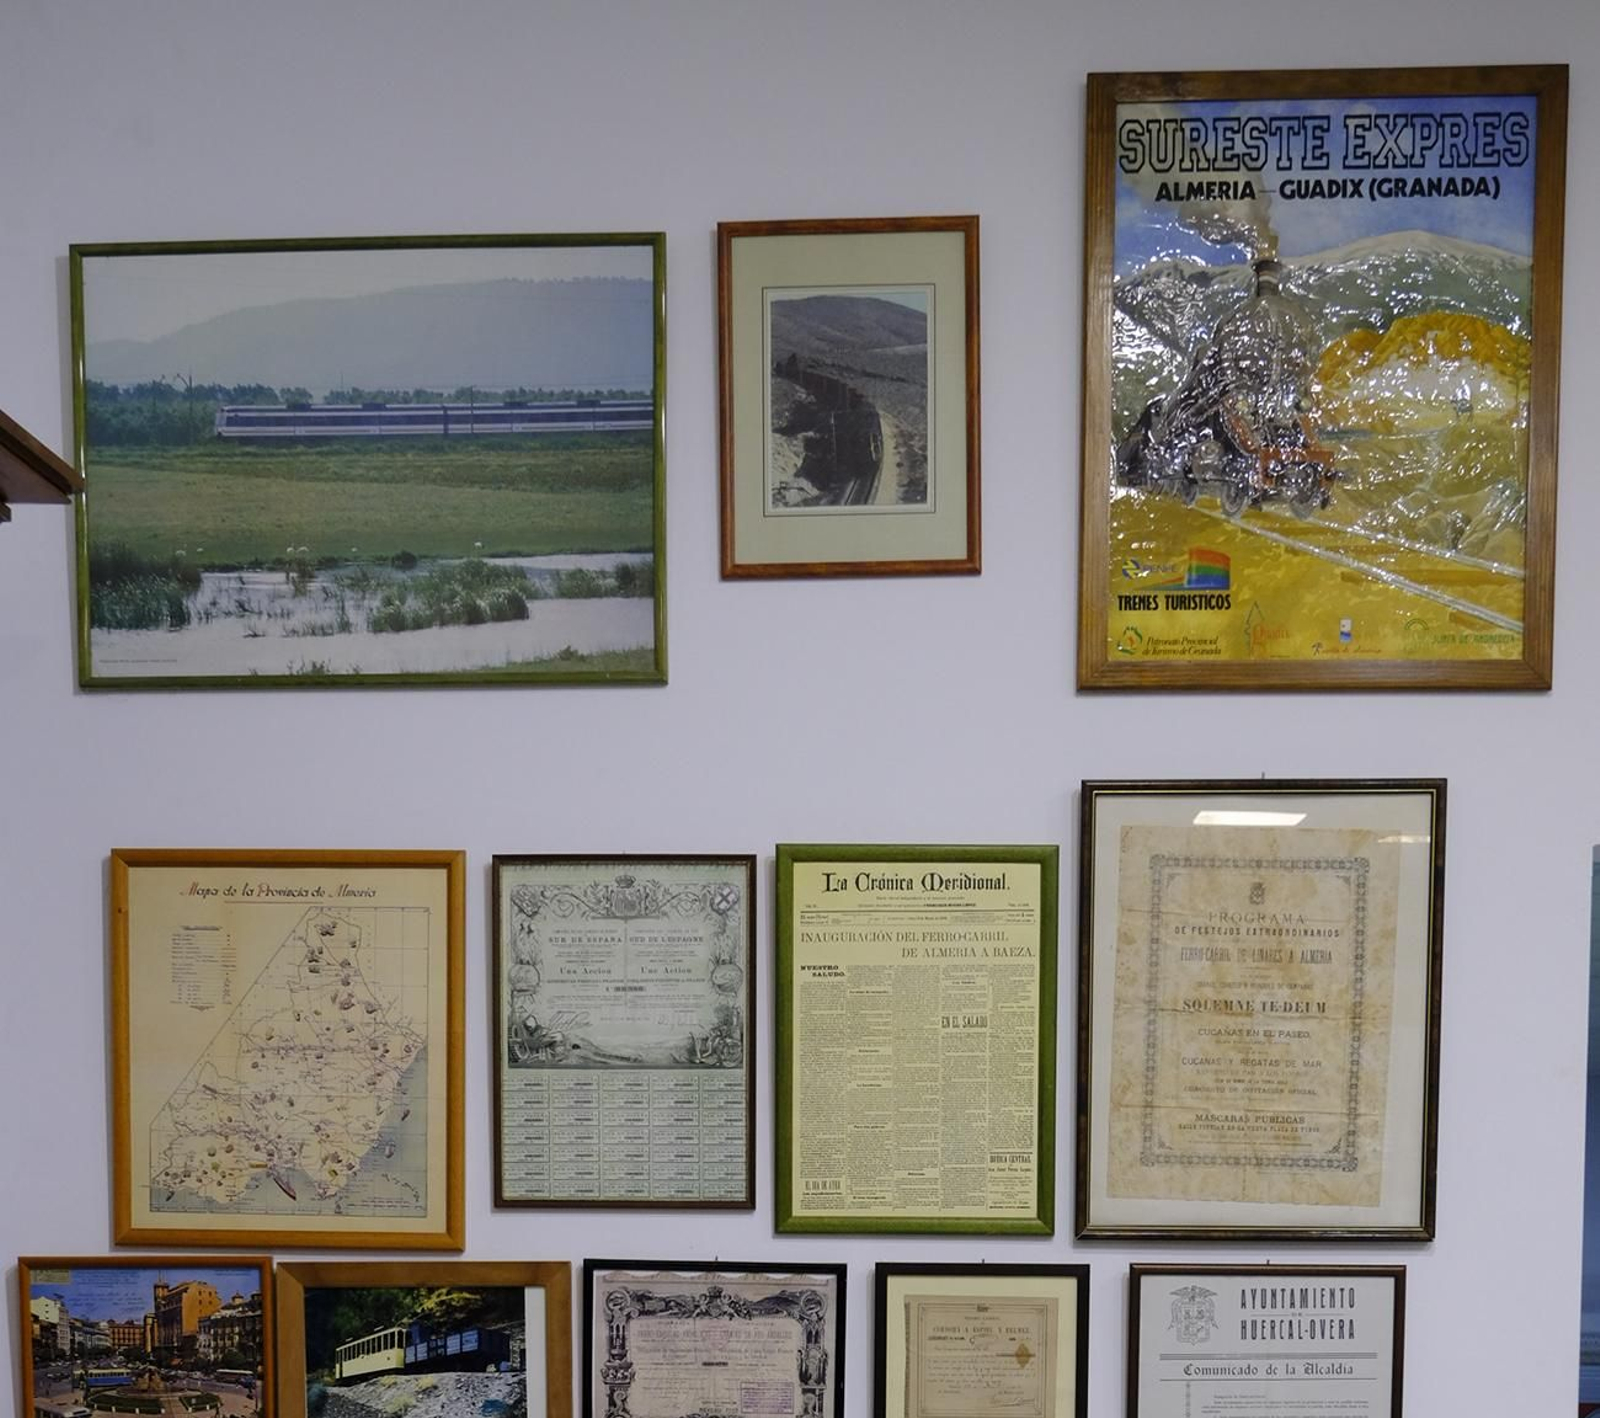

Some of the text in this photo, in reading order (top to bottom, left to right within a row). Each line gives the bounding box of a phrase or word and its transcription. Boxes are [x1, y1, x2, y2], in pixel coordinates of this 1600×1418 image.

[1118, 111, 1530, 173] SURESTE EXPRES
[1154, 175, 1501, 202] ALMERIA GUADIX (GRANADA)
[1117, 593, 1232, 611] TRENES TURISTICOS
[223, 885, 237, 897] de
[242, 883, 254, 897] la
[257, 882, 309, 898] Provincia
[311, 885, 326, 898] de
[821, 872, 848, 893] La
[855, 872, 914, 893] Crónica
[1208, 911, 1305, 925] PROGRAMA
[800, 930, 893, 943] INAUGURACIÓN
[896, 931, 920, 943] DEL
[901, 947, 918, 959] DE
[979, 947, 990, 958] A
[1240, 1287, 1355, 1310] AYUNTAMIENTO
[1240, 1319, 1355, 1341] HUERCAL-OVERA
[1183, 1363, 1258, 1377] Comunicado
[1265, 1364, 1278, 1376] de
[1286, 1363, 1296, 1375] la
